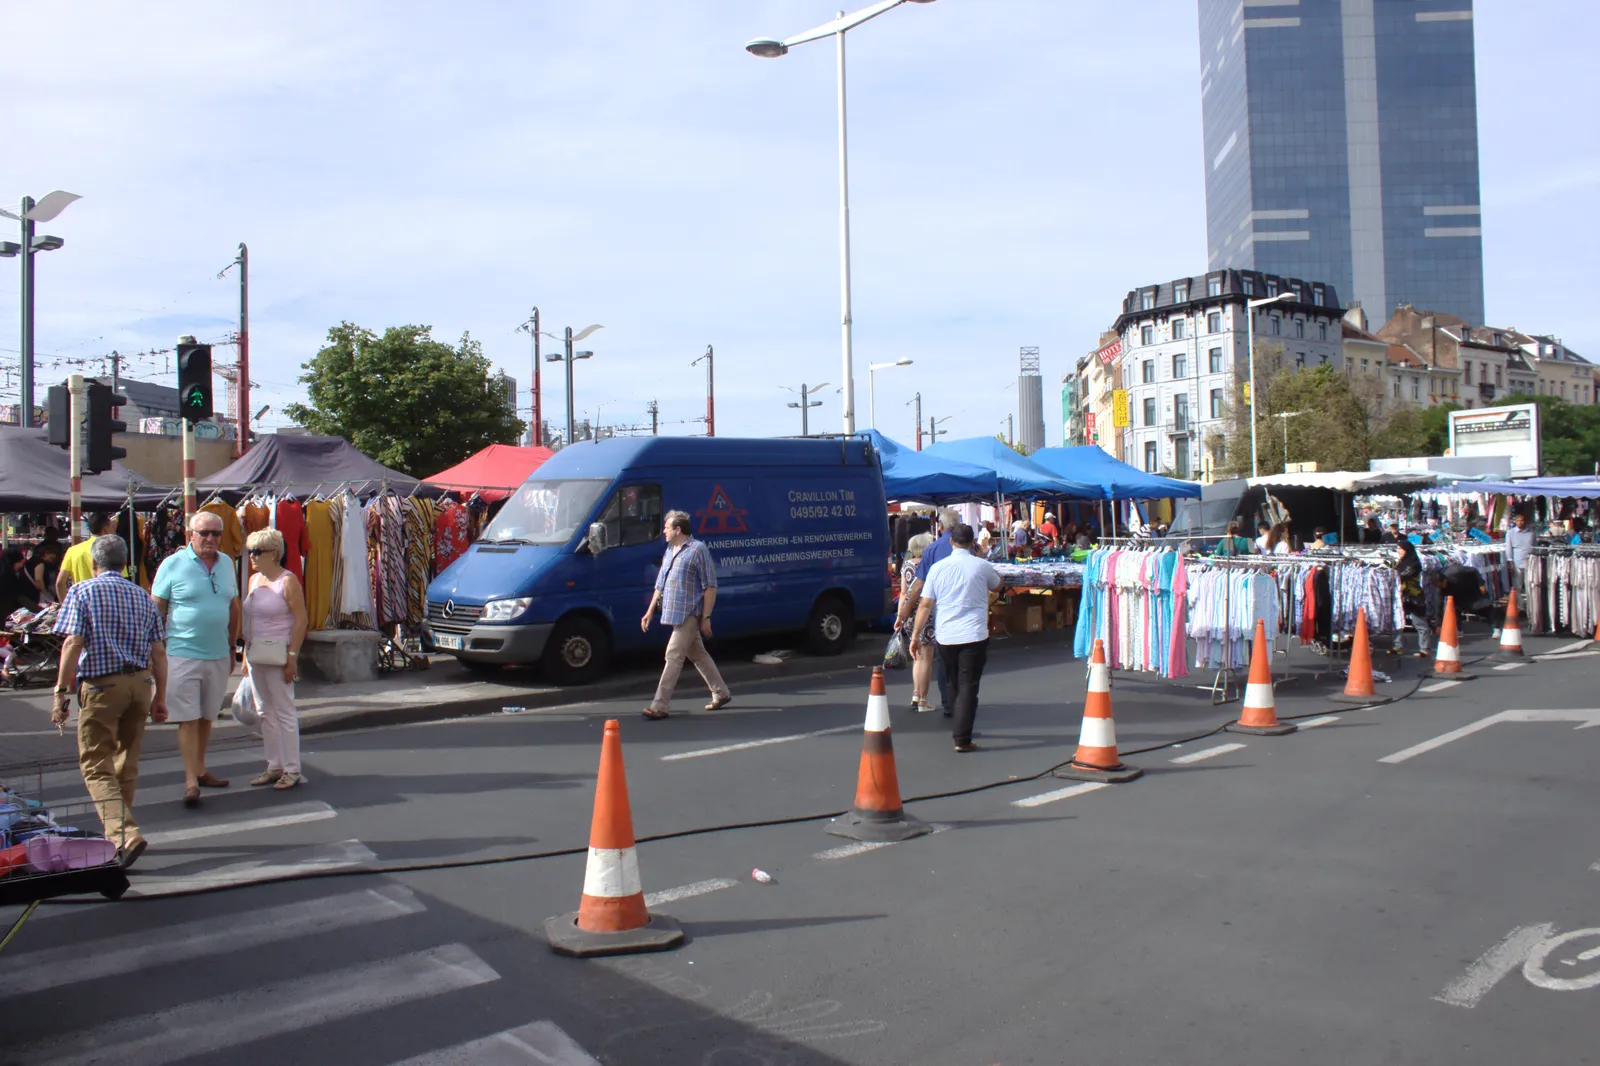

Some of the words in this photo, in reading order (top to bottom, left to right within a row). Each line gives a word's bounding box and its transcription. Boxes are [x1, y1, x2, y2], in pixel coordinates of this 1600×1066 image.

[790, 506, 829, 519] 0495/92
[831, 505, 843, 517] 42
[844, 505, 857, 517] 02
[804, 532, 873, 543] RENOVATIEWERKEN
[720, 548, 854, 567] WWW.AT-AANNEMINGSWERKEN.BE
